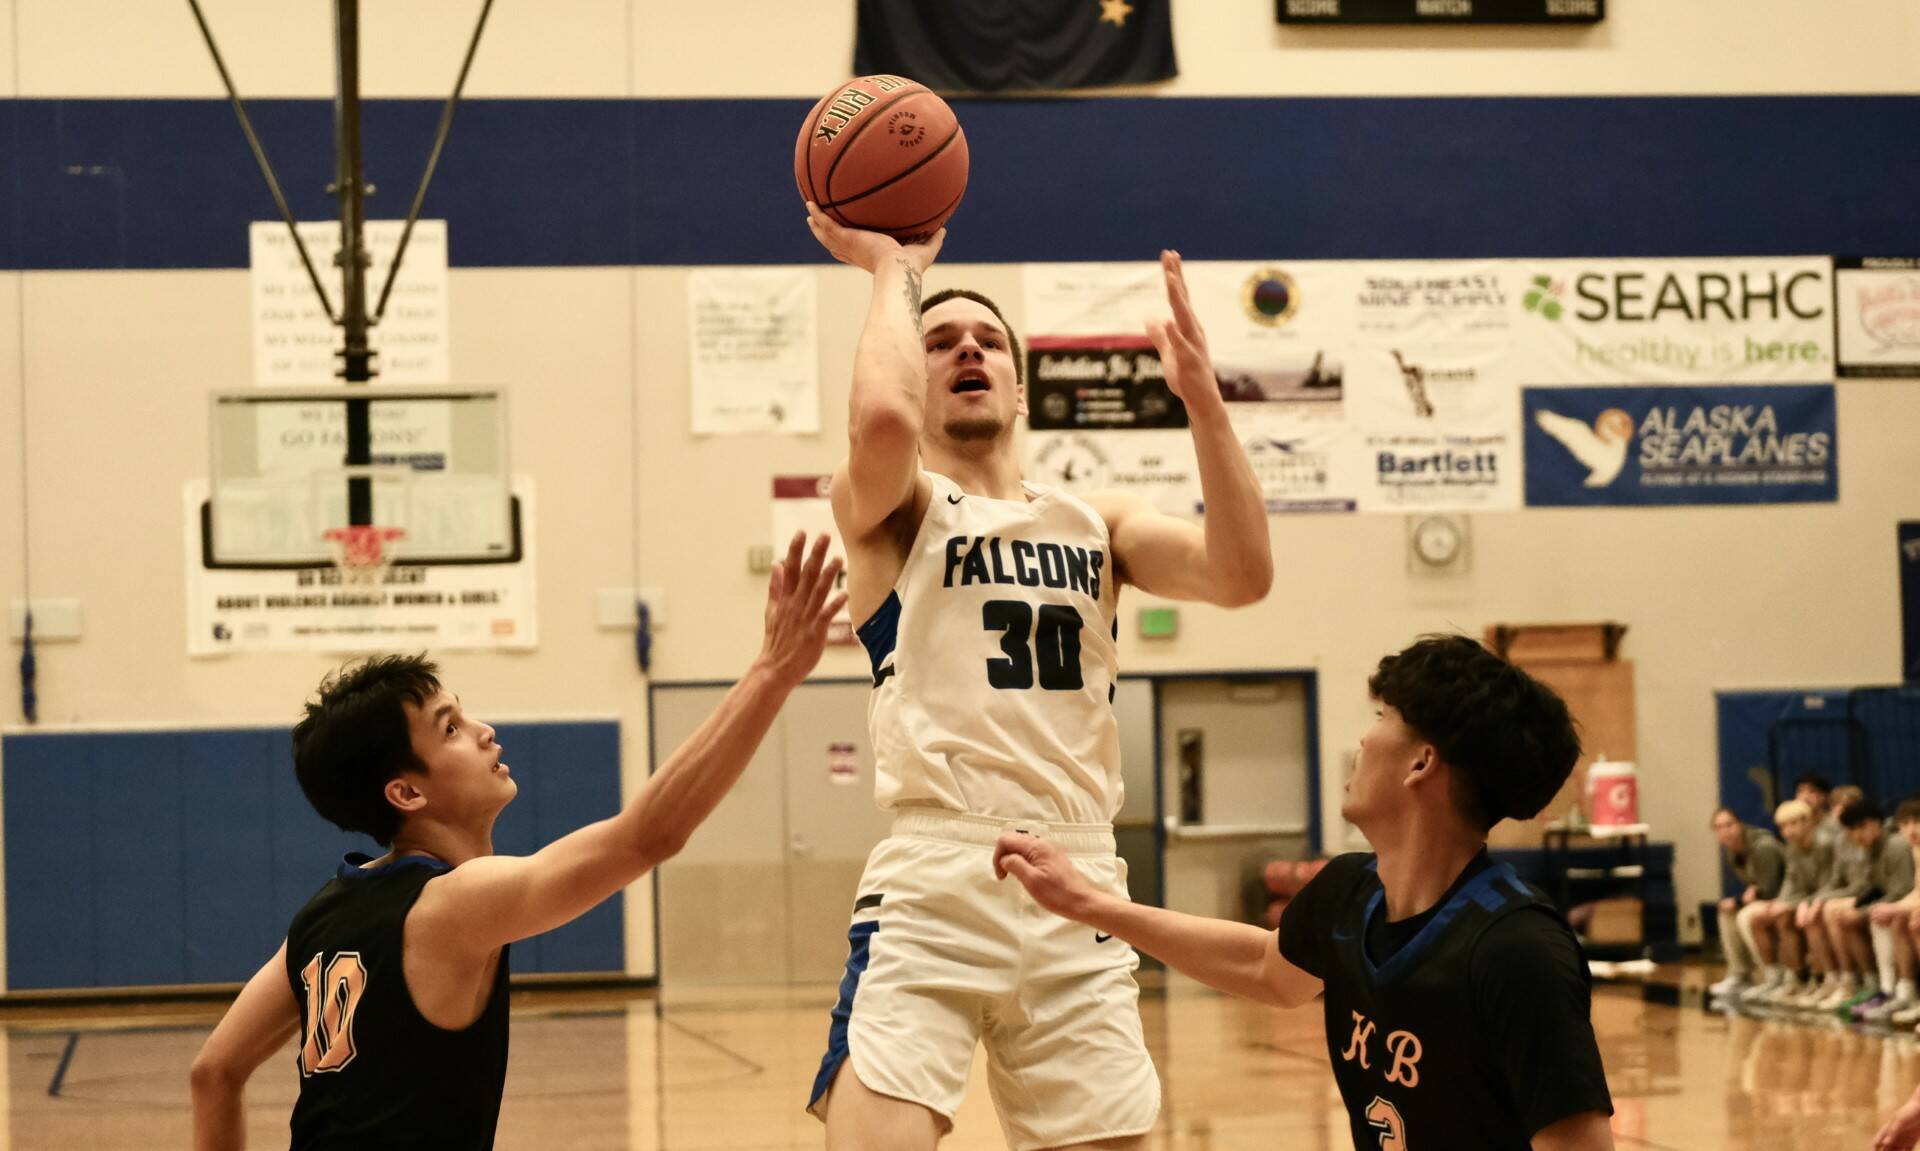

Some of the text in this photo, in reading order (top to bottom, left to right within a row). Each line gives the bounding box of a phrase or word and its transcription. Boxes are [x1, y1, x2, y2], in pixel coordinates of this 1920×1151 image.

[815, 88, 877, 144] ROCK
[1575, 272, 1825, 322] SEARHC
[1576, 336, 1829, 368] healthy is here.
[1639, 404, 1778, 435] ALASKA
[1378, 451, 1498, 474] Bartlett
[1639, 431, 1830, 467] SEAPLANES
[944, 536, 1104, 601] FALCONS
[983, 600, 1084, 691] 30
[301, 950, 368, 1078] 10
